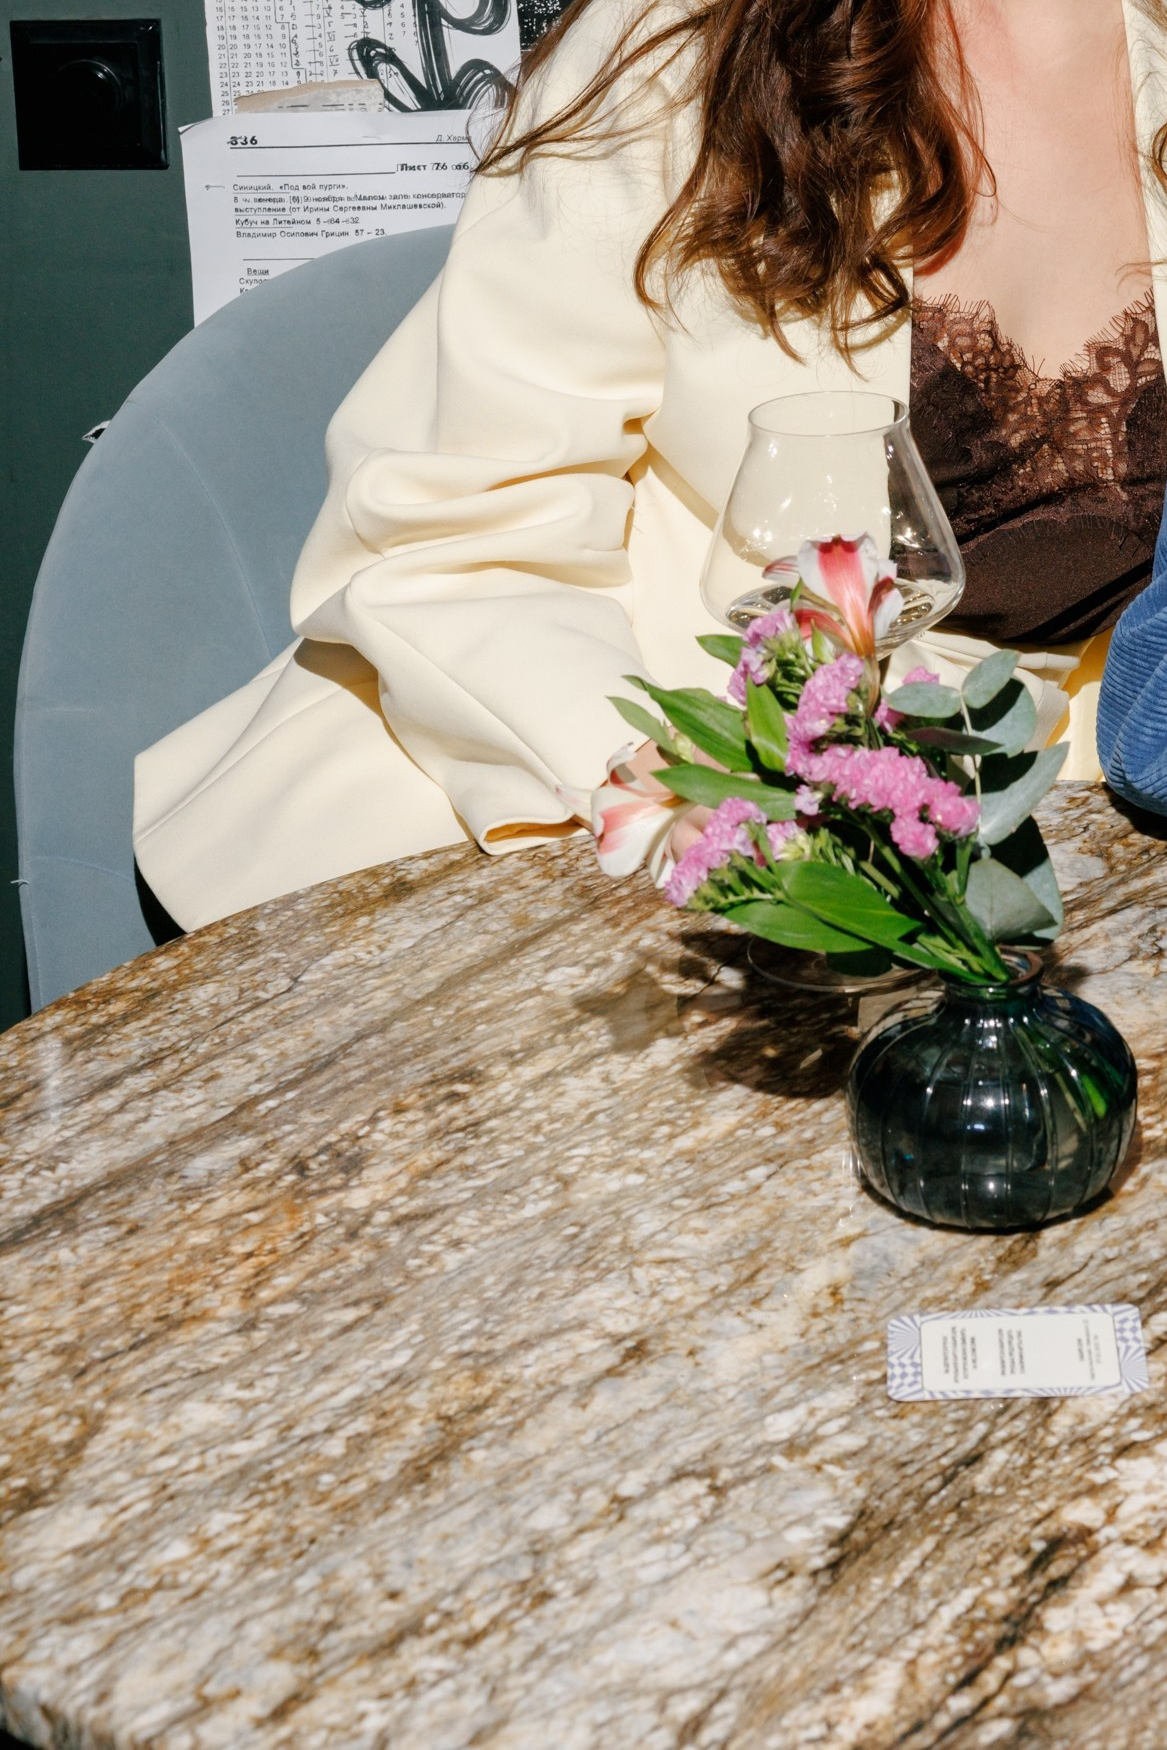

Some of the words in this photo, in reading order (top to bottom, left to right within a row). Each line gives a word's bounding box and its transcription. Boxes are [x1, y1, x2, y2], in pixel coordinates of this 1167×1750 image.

[234, 206, 286, 214] выступление
[303, 205, 330, 213] Ирины
[333, 204, 377, 212] Сергеевны
[236, 230, 276, 239] Владимир
[247, 267, 270, 276] Вещи
